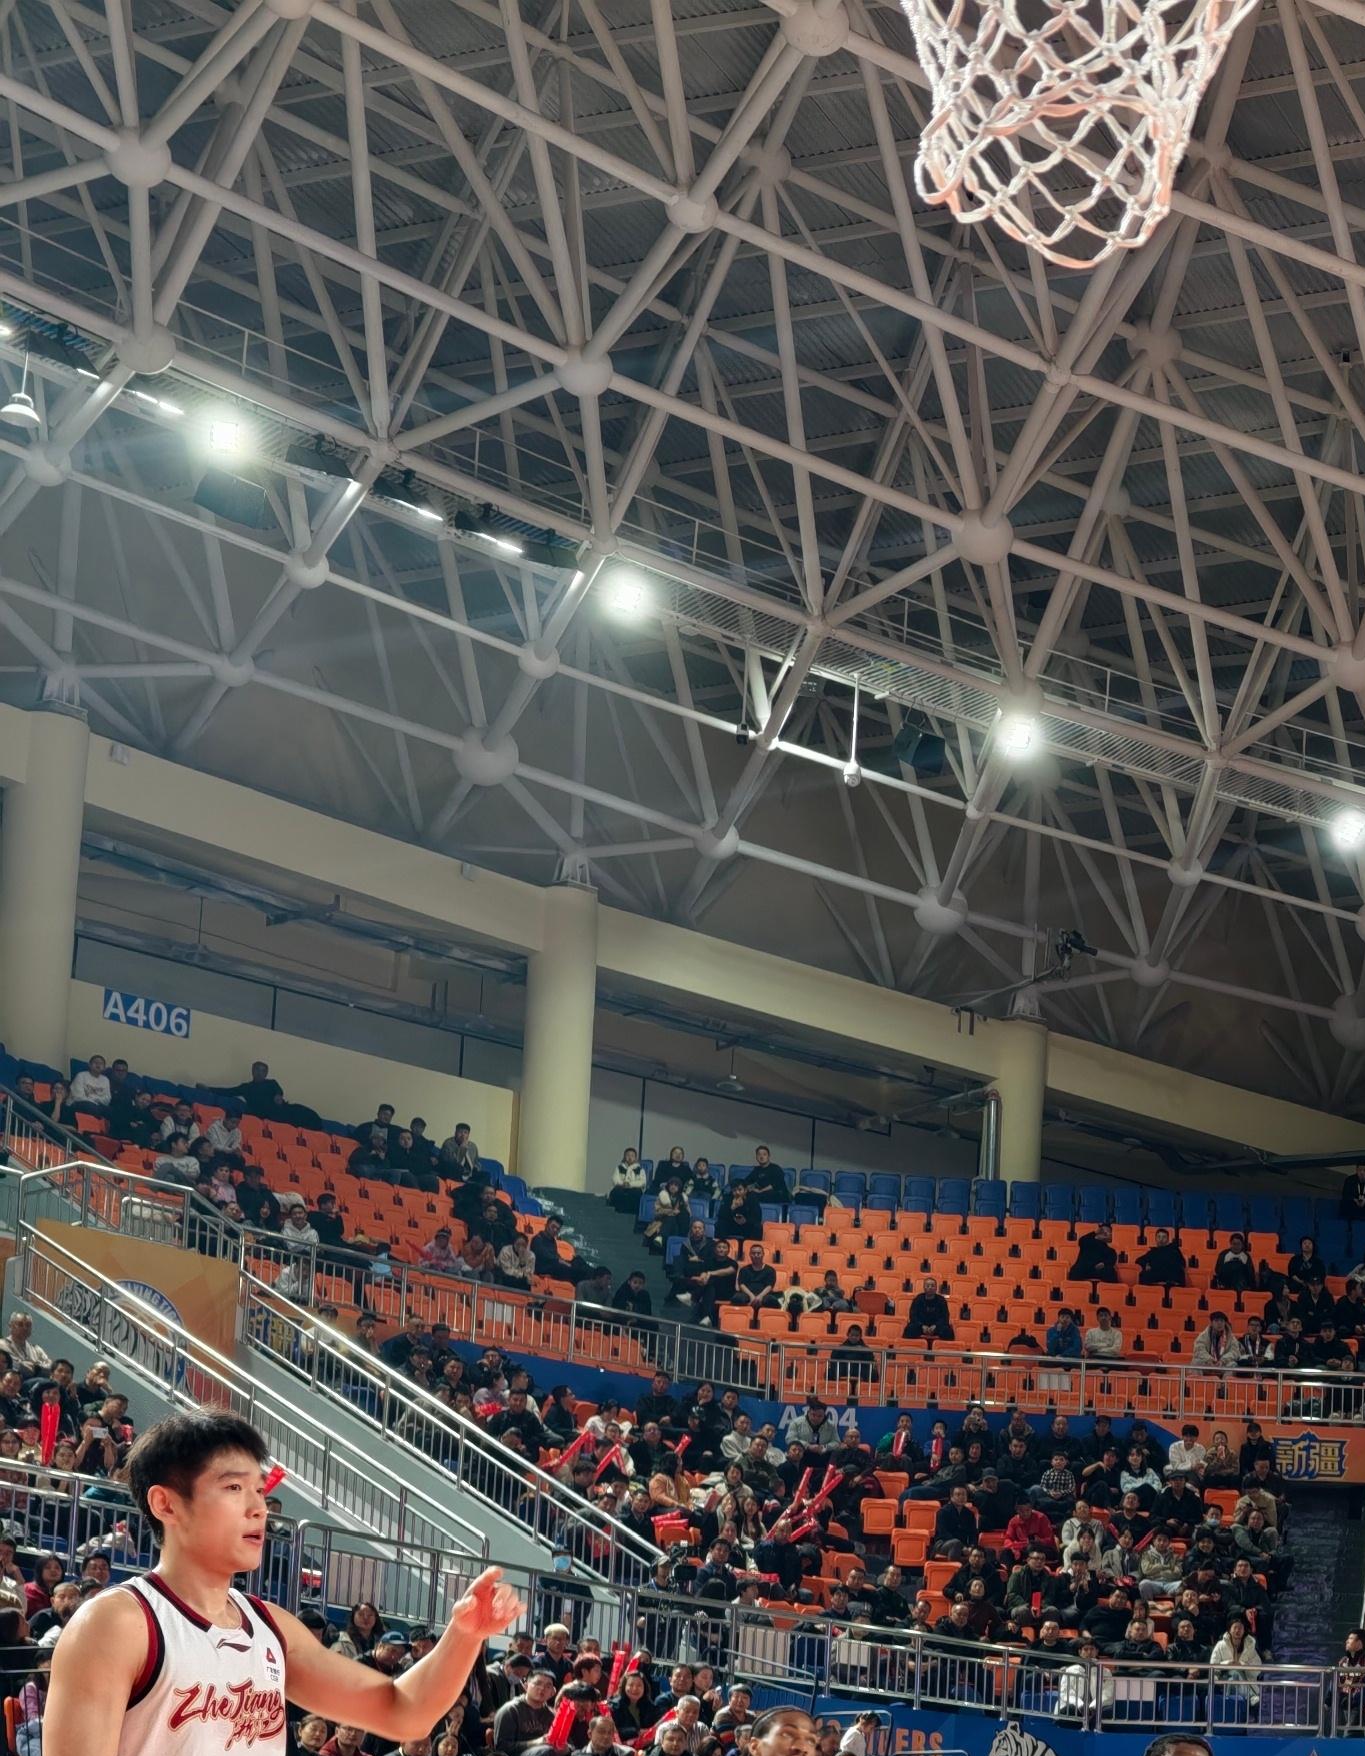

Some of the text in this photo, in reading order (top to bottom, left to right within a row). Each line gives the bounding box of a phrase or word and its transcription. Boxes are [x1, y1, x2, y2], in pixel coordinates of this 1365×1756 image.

[104, 991, 188, 1038] A406
[778, 1404, 858, 1430] A04
[1275, 1440, 1343, 1477] 新疆
